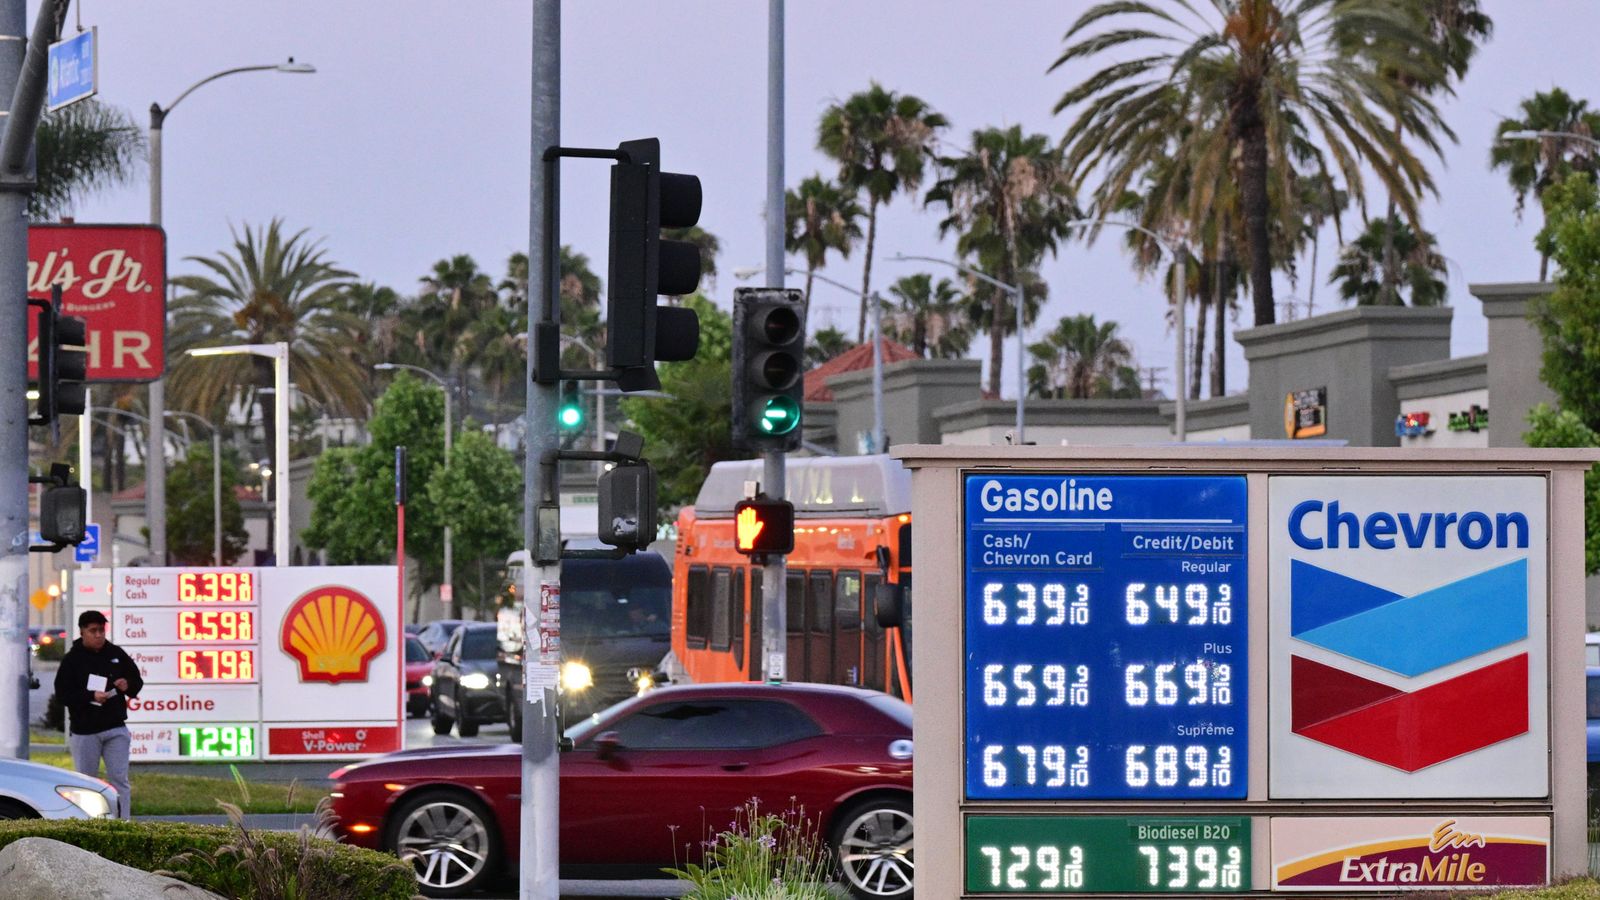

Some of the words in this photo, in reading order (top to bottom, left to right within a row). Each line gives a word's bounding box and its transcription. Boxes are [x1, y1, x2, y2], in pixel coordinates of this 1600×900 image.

[82, 249, 152, 299] Jr.
[981, 479, 1113, 512] Gasoline
[1288, 500, 1529, 550] Chevron
[983, 533, 1032, 550] Cash/
[1133, 535, 1234, 551] Credit/Debit
[983, 551, 1050, 566] Chevron
[1055, 551, 1093, 566] Card
[1182, 561, 1232, 574] Regular
[125, 575, 160, 588] Regular
[125, 589, 147, 599] Cash
[125, 614, 144, 624] Plus
[125, 628, 147, 638] Cash
[1203, 643, 1233, 654] Plus
[127, 694, 215, 711] Gasoline
[157, 730, 172, 741] #2
[302, 730, 325, 740] Shell
[1177, 722, 1235, 736] Suprême
[130, 745, 147, 755] ash
[303, 740, 362, 752] V-Power
[1138, 825, 1199, 840] Biodiesel
[1203, 825, 1230, 840] B20
[1339, 853, 1486, 882] ExtraMile
